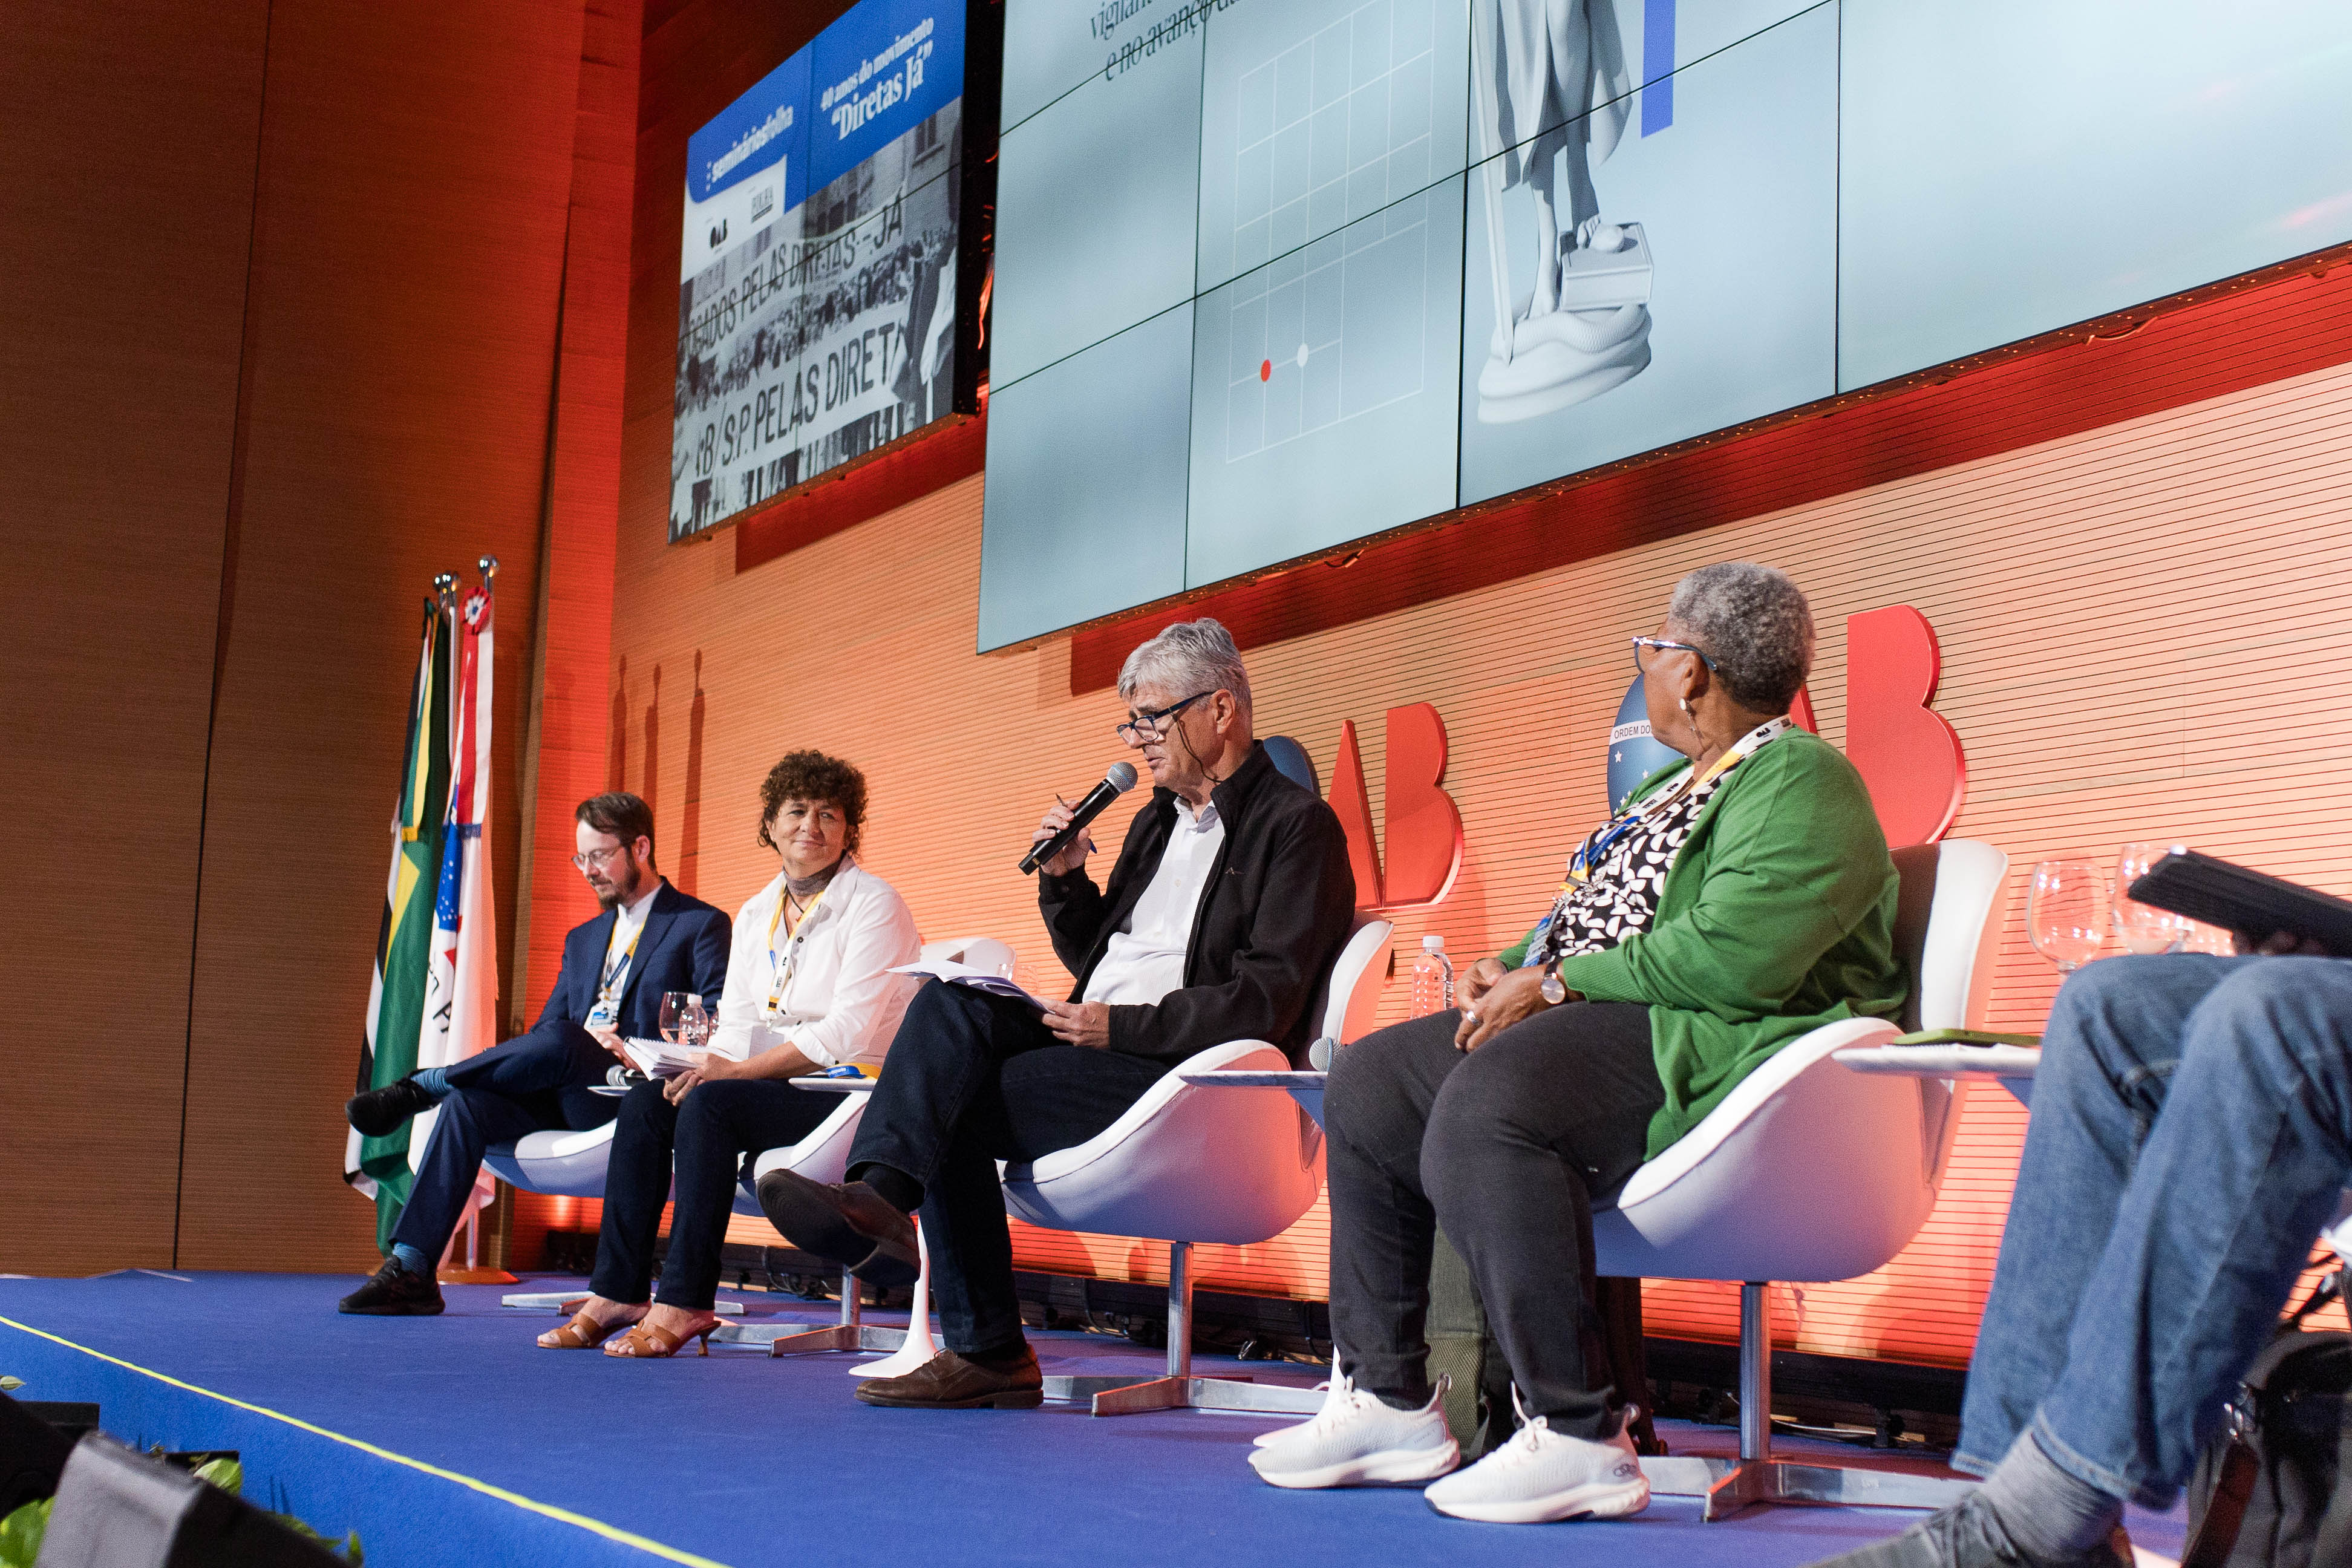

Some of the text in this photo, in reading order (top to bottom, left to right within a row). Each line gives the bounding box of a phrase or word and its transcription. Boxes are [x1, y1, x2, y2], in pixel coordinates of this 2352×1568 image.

[872, 16, 934, 75] movimento
[1105, 51, 1117, 82] e
[1120, 36, 1143, 74] no
[741, 242, 786, 322] PELAS
[753, 364, 819, 452] PELAS
[1614, 725, 1651, 739] ORDEM DO
